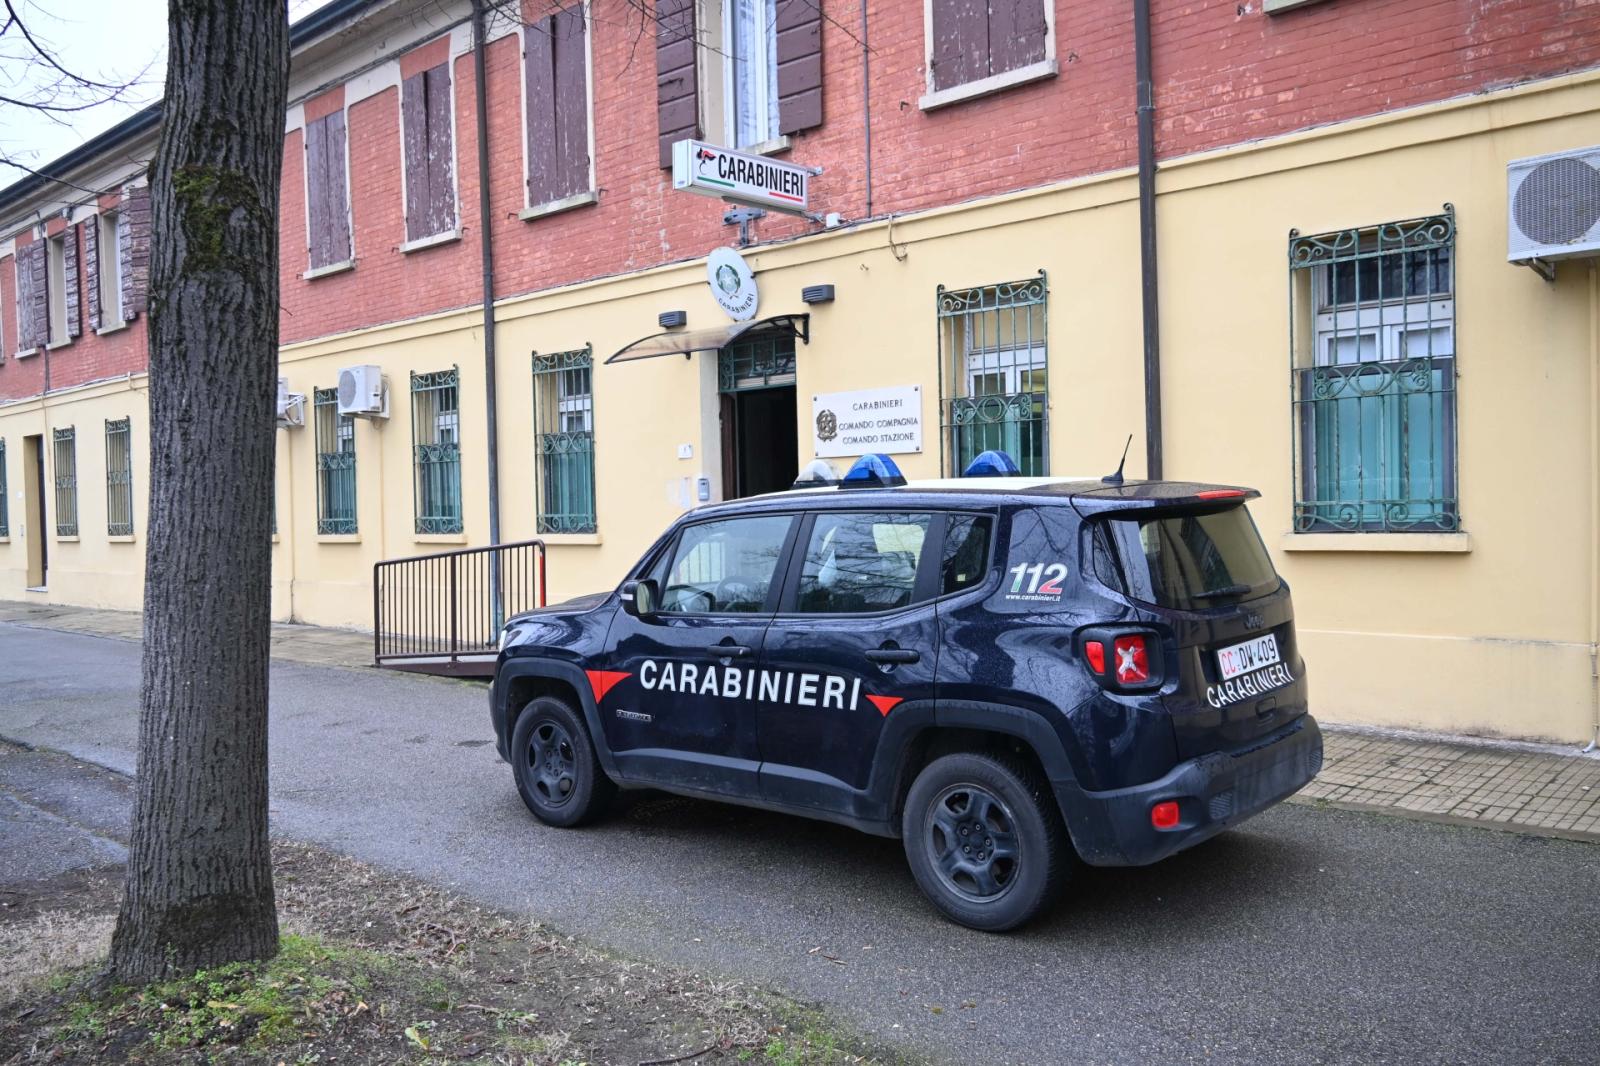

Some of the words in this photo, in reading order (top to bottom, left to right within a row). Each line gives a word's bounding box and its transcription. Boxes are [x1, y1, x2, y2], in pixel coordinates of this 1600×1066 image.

[718, 154, 803, 197] CARABINIERI
[718, 293, 754, 313] CARABINIERI
[852, 399, 903, 411] CARABINIERI
[839, 420, 874, 431] COMANDO
[876, 417, 918, 429] COMPAGNIA
[842, 435, 878, 445] COMANDO
[880, 432, 914, 443] STAZIONE
[1010, 562, 1068, 595] 112
[1005, 594, 1061, 602] www.carabinieri.it
[1220, 651, 1236, 676] CC
[1238, 645, 1255, 670] DW
[1257, 638, 1277, 663] 409
[639, 659, 861, 711] CARABINIERI
[1206, 662, 1295, 708] CARABINIERI
